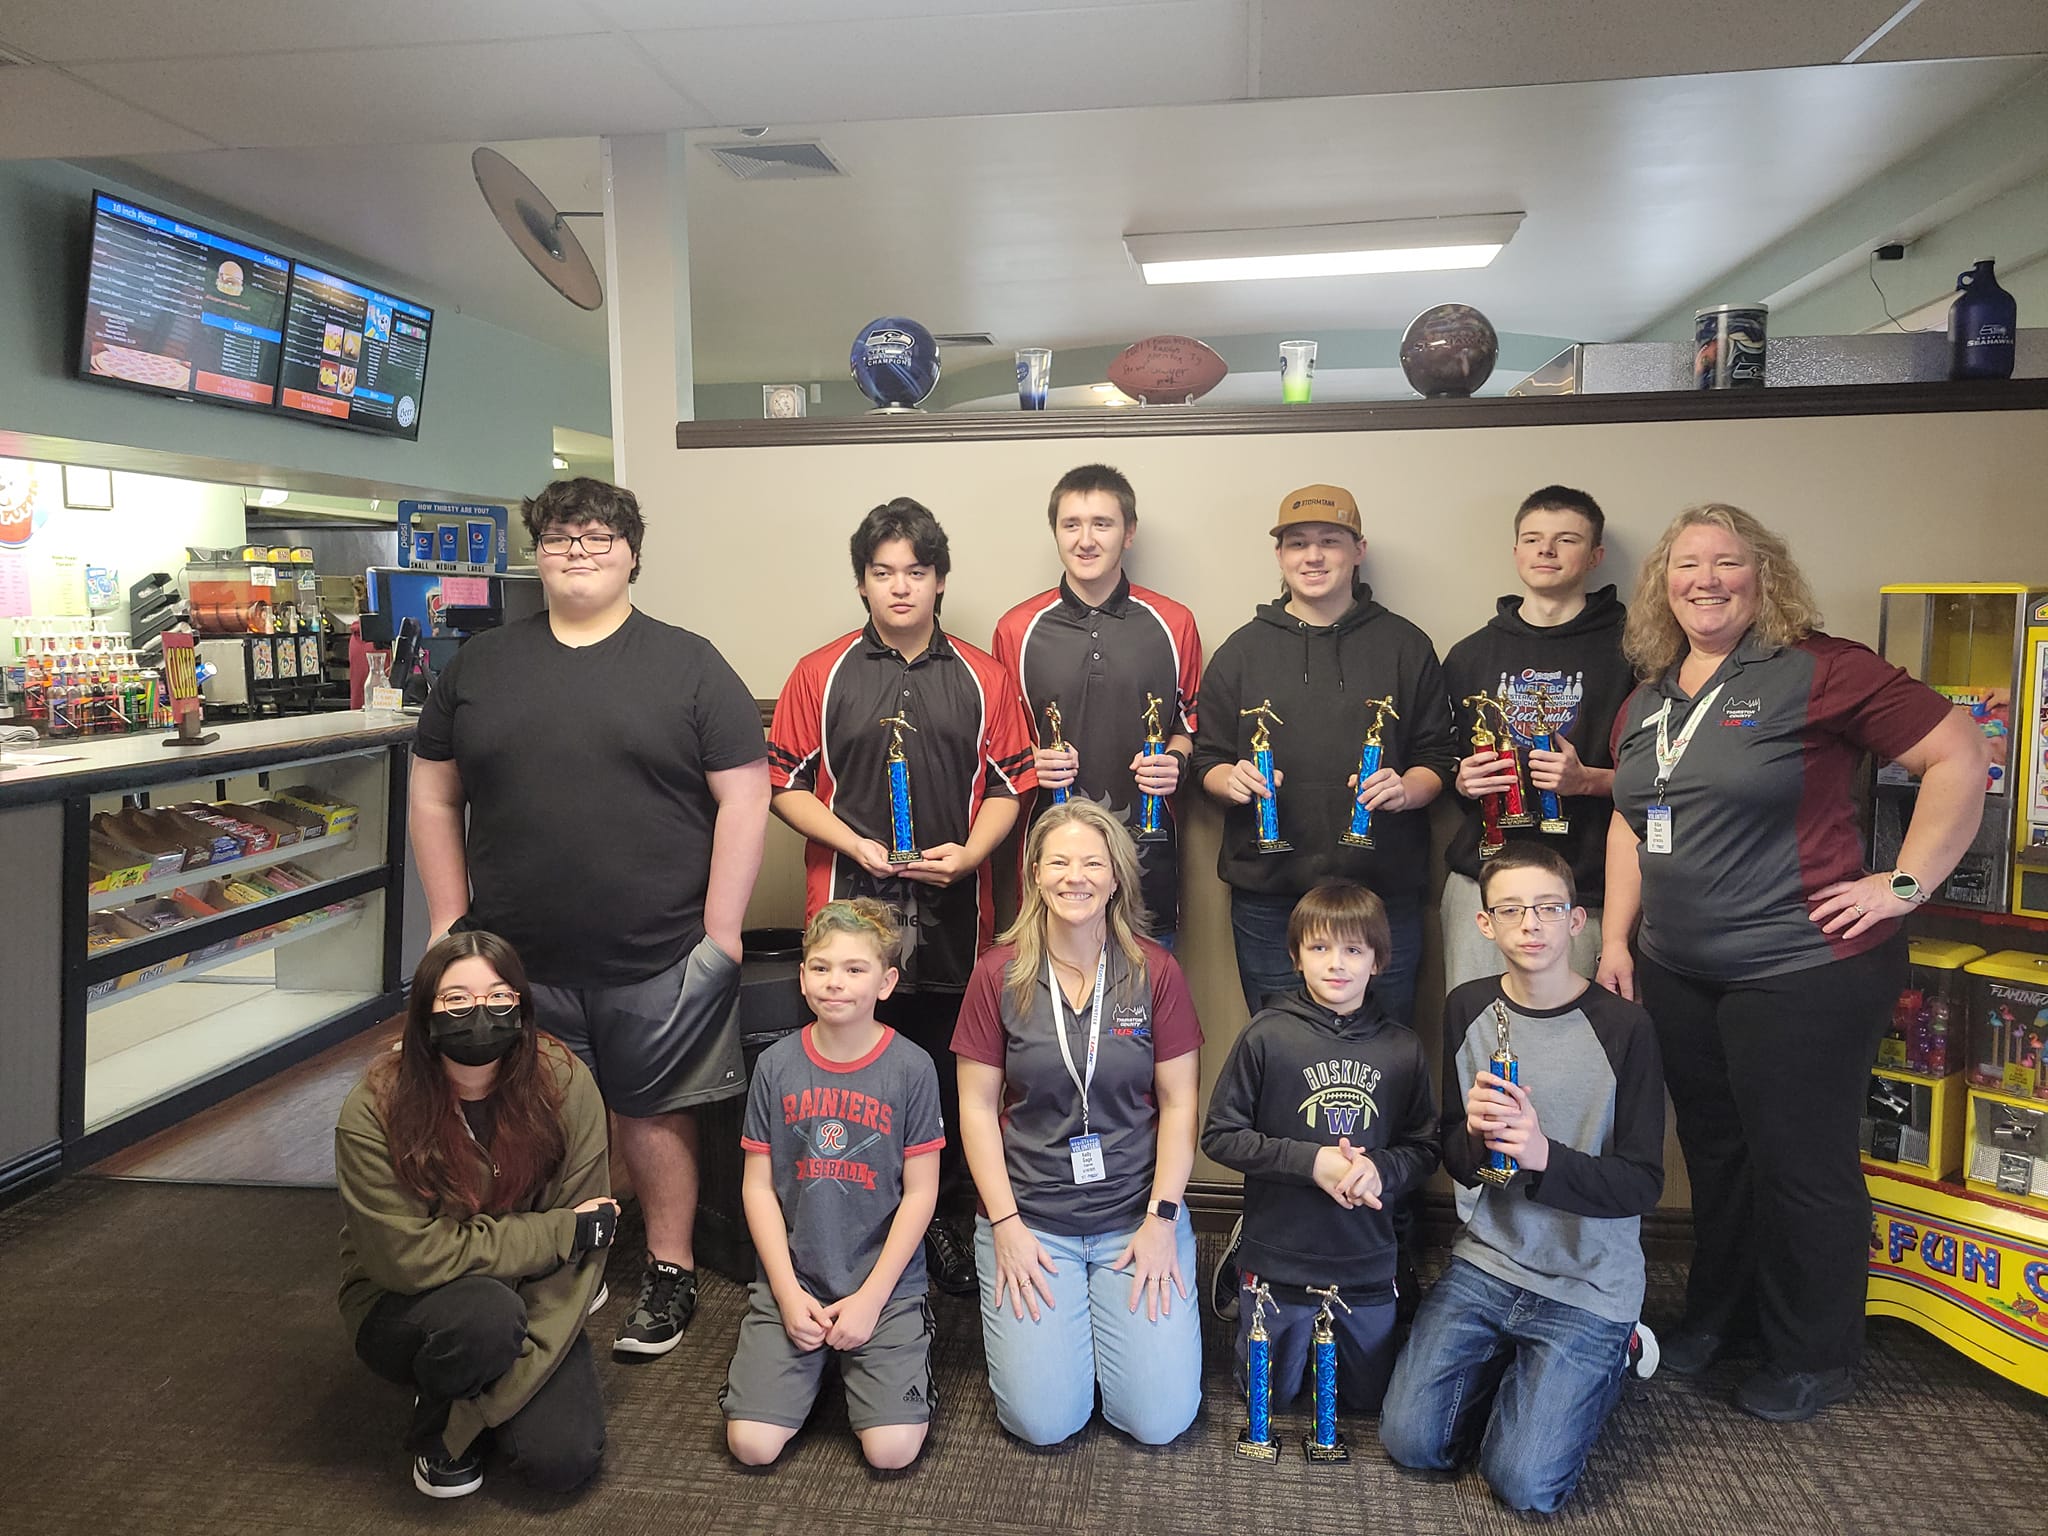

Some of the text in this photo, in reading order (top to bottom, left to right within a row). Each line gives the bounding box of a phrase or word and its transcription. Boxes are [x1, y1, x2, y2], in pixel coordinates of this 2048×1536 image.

[112, 203, 158, 226] 10 inch Pizzas
[174, 224, 198, 239] Burgers
[418, 503, 489, 515] HOW THIRSTY ARE YOU?
[400, 522, 409, 549] pepsi
[410, 562, 485, 573] SMALL MEDIUM LARGE
[167, 647, 198, 699] CLOSED
[1303, 1060, 1381, 1095] HUSKIES
[782, 1087, 893, 1135] RAINIERS
[1324, 1108, 1360, 1135] W
[1889, 1220, 2001, 1290] FUN
